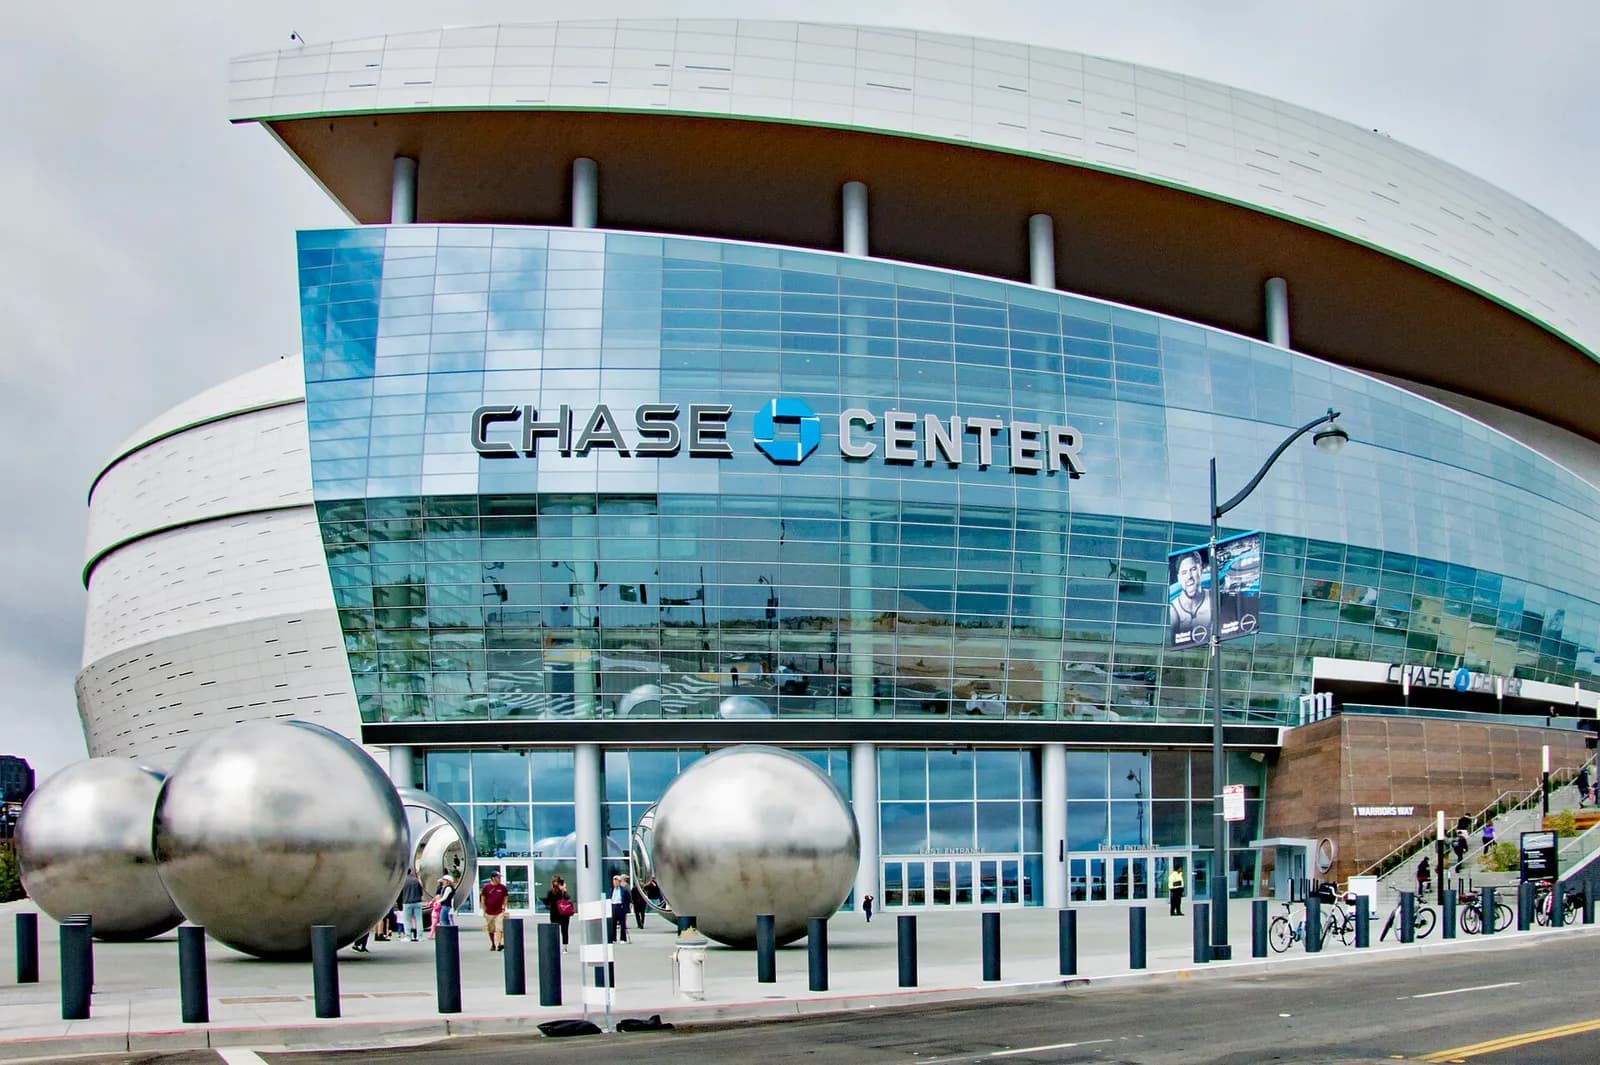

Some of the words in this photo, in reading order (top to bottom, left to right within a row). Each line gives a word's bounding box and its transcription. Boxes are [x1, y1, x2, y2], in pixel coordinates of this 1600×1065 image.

[470, 403, 734, 457] CHASE
[839, 408, 1086, 478] CENTER
[1387, 664, 1450, 688] CHASE
[1358, 806, 1397, 816] WARRIORS
[1398, 806, 1414, 816] WAY
